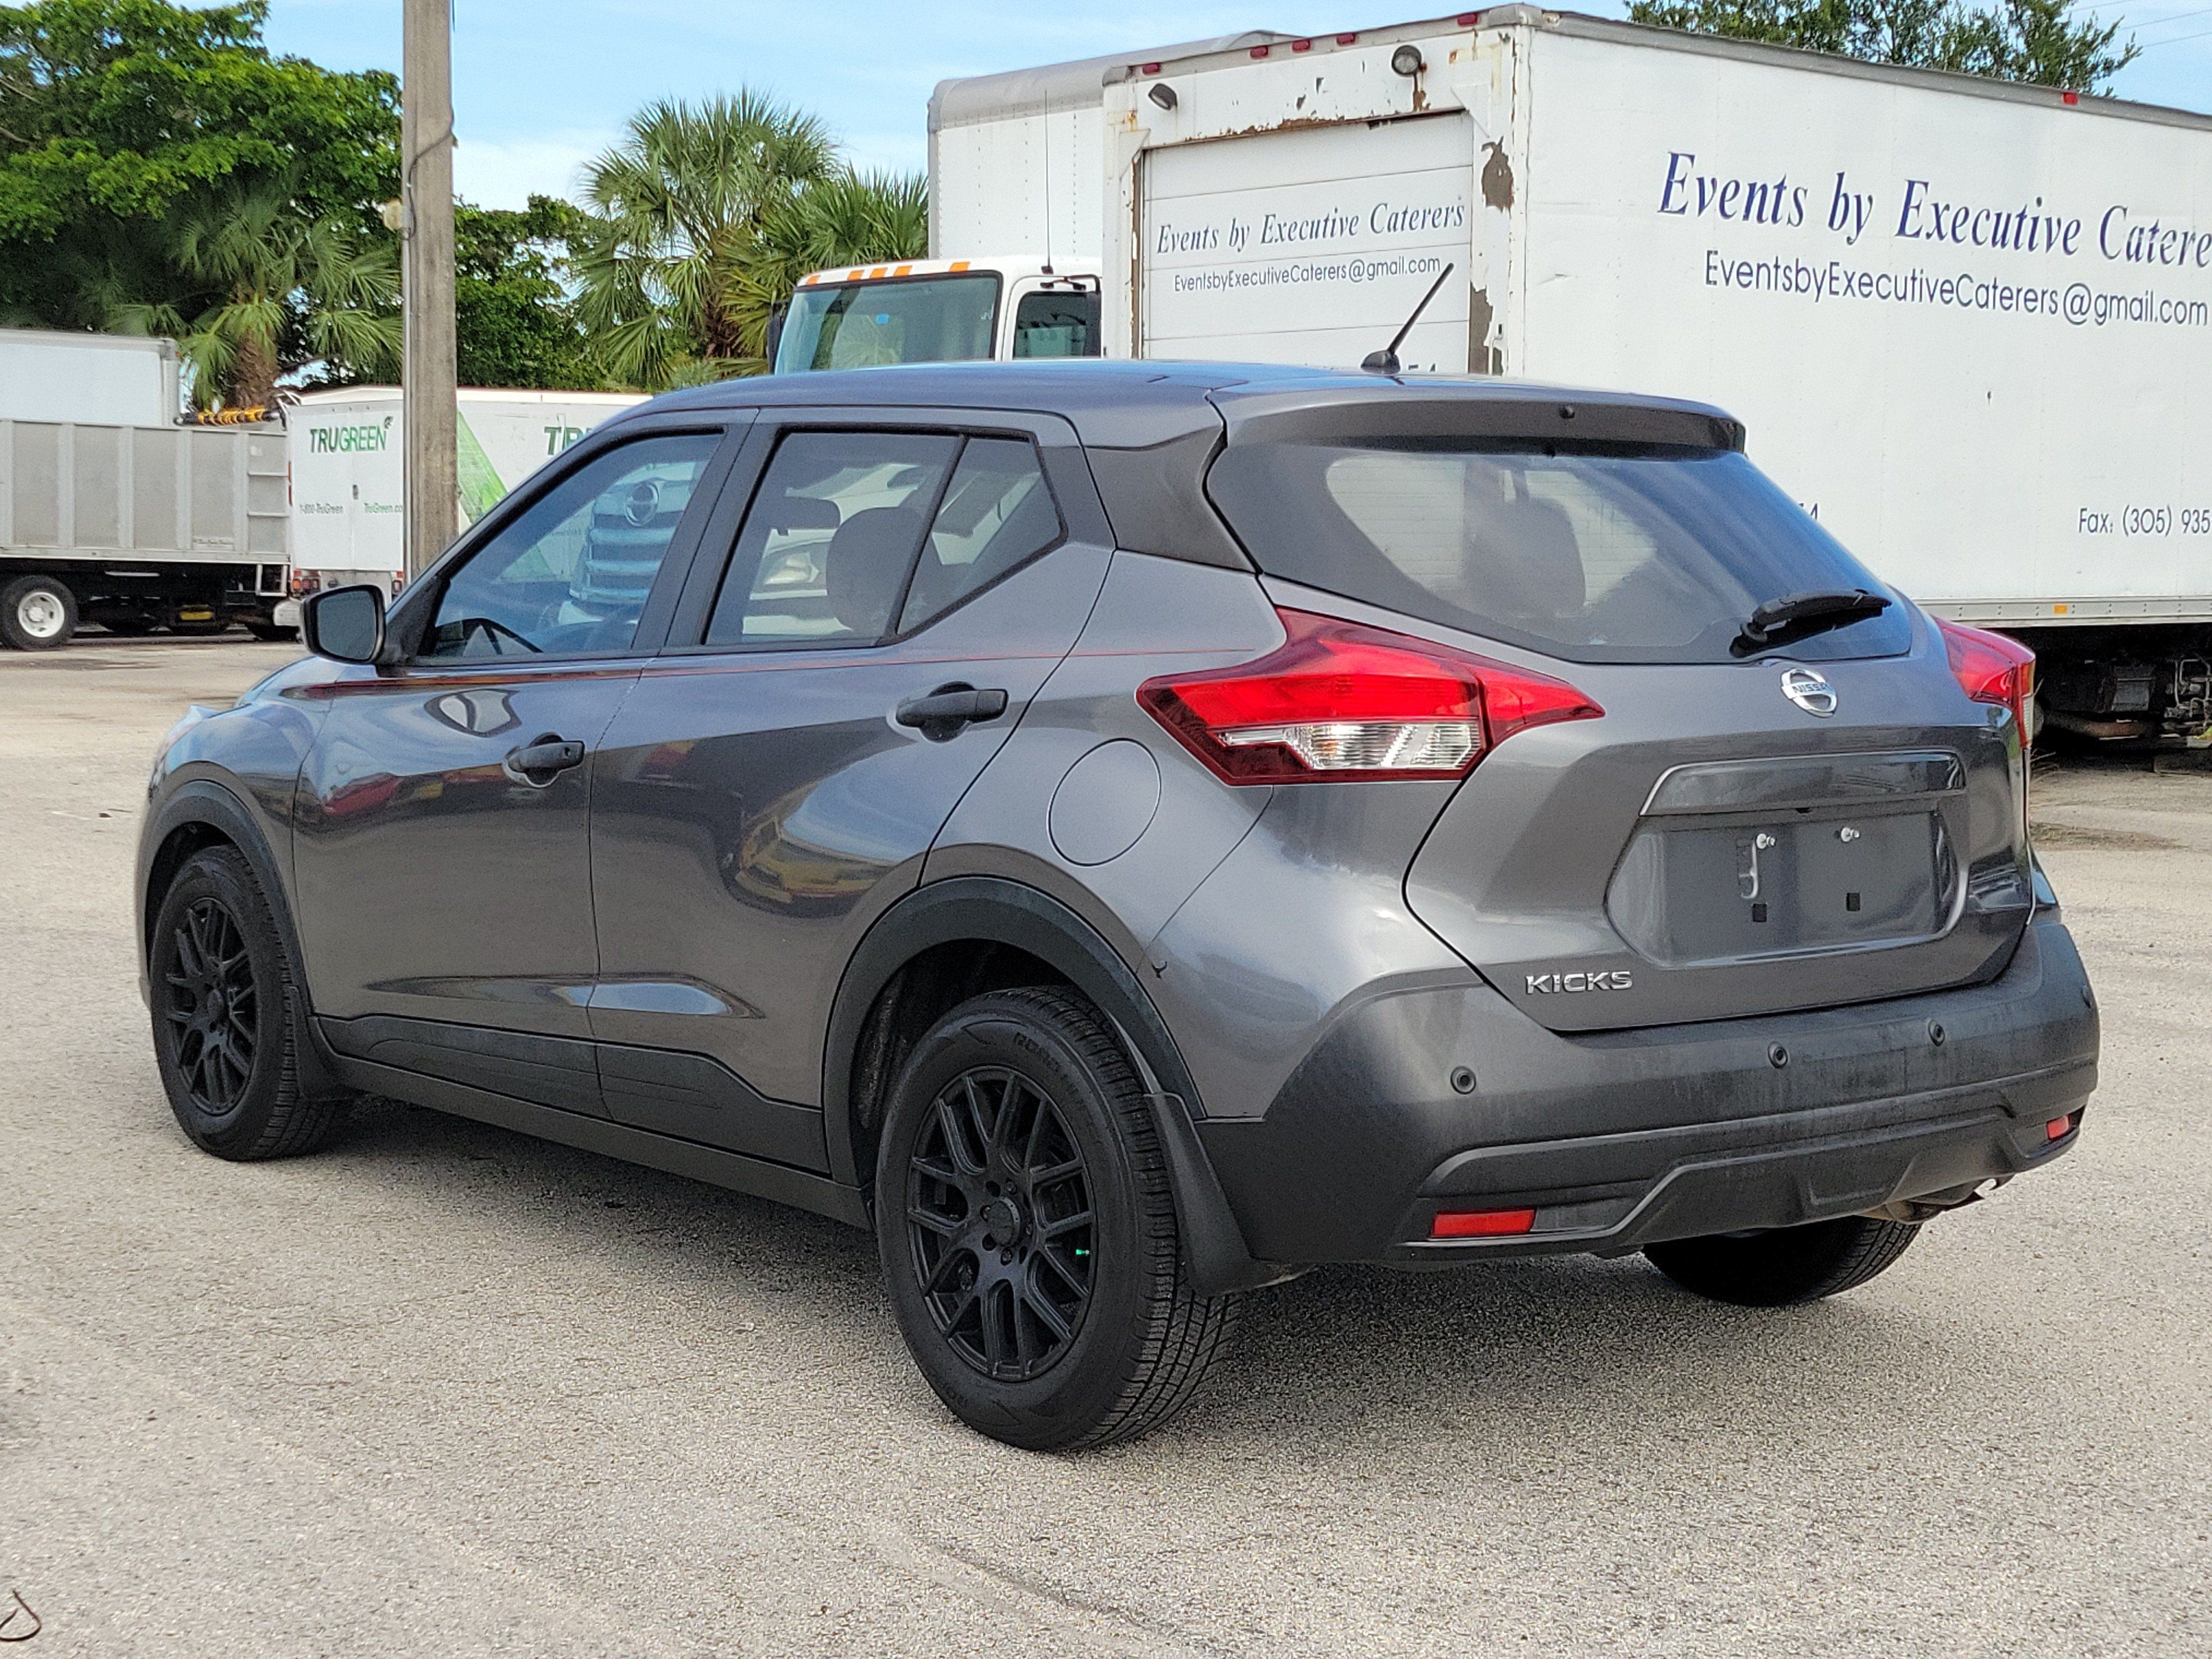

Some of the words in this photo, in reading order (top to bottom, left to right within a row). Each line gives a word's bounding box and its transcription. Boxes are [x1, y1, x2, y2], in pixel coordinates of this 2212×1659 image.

[1657, 151, 1808, 227] Events
[1828, 172, 1873, 246] by
[1895, 179, 2081, 256] Executive
[1157, 224, 1219, 253] Events
[1228, 218, 1250, 252] by
[1260, 206, 1359, 244] Executive
[1370, 202, 1465, 235] Caterers
[1174, 256, 1441, 292] EventsbyExecutiveCaterers@gmail.com
[1706, 250, 2209, 326] EventsbyExecutiveCaterers@gmail.com
[310, 425, 387, 453] TRUGREEN
[544, 426, 592, 455] TR
[2079, 507, 2113, 533] Fax:
[2123, 504, 2172, 537] (305)
[2181, 509, 2212, 534] 935
[1525, 971, 1633, 994] KICKS
